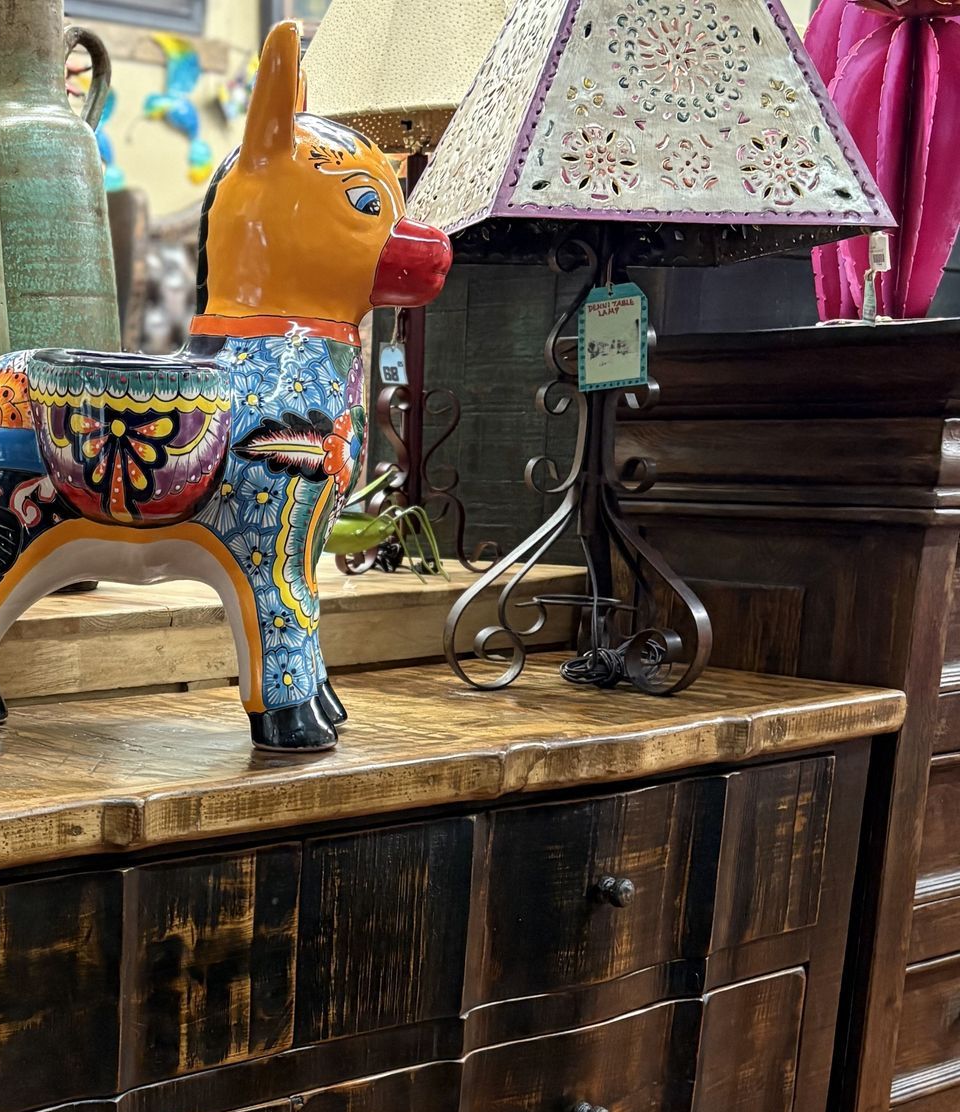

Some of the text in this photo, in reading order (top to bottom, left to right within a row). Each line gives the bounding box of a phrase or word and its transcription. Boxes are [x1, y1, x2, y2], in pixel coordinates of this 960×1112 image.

[612, 298, 635, 307] TABLE
[598, 307, 620, 317] LAMP
[382, 366, 400, 381] 68
